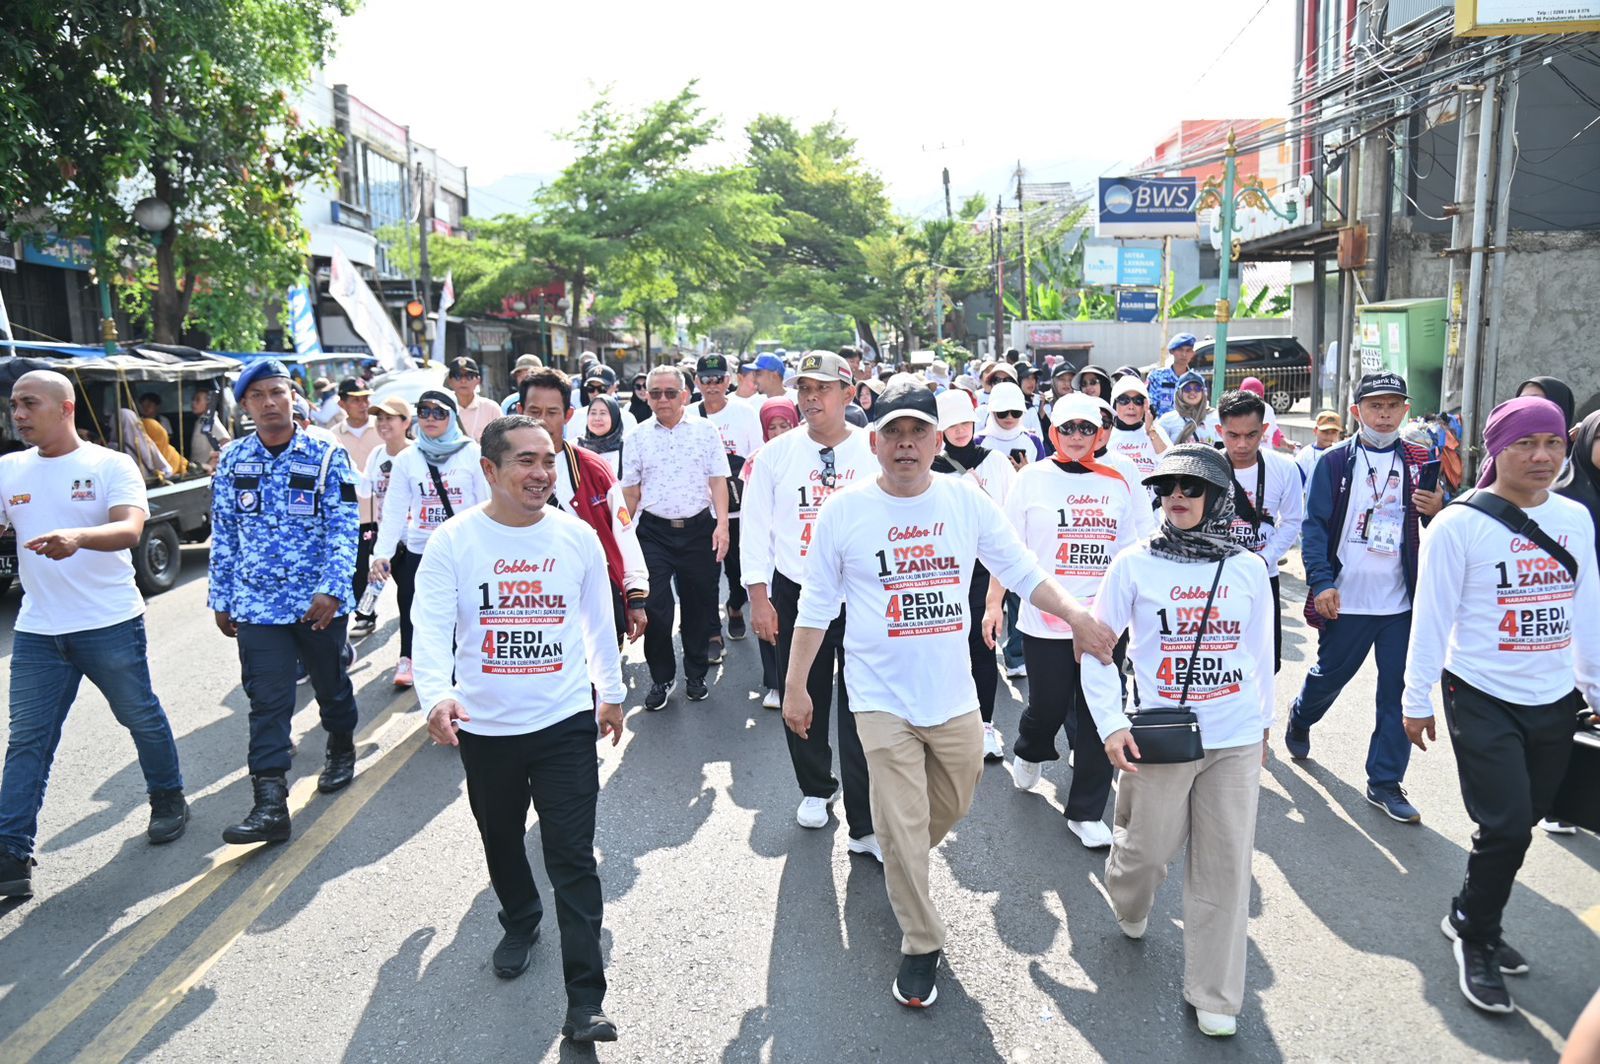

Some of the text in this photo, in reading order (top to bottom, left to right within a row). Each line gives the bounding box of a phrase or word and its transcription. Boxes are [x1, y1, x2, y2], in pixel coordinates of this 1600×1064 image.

[1136, 186, 1190, 207] BWS
[1362, 358, 1380, 366] CCTV
[1372, 378, 1390, 386] bank
[798, 486, 810, 507] 1
[419, 506, 428, 522] 4
[1057, 508, 1068, 528] 1
[1071, 508, 1104, 516] IYOS
[1072, 518, 1118, 530] ZAINUL
[800, 523, 812, 545] 4
[893, 544, 936, 560] IYOS
[1056, 543, 1069, 564] 4
[1070, 544, 1104, 554] DEDI
[875, 549, 892, 578] 1
[895, 556, 960, 575] ZAINUL
[1516, 557, 1560, 572] IYOS
[1495, 561, 1512, 588] 1
[1518, 570, 1574, 587] ZAINU
[479, 582, 494, 610] 1
[498, 580, 542, 595] IYOS
[1496, 588, 1526, 596] PASANGAN
[498, 594, 567, 609] ZAINUL
[902, 591, 944, 607] DEDI
[886, 594, 902, 623] 4
[902, 602, 963, 621] ERWAN
[1521, 606, 1565, 622] DEDI
[1156, 608, 1172, 636] 1
[1498, 610, 1519, 638] 4
[481, 630, 496, 660] 4
[496, 631, 542, 644] DEDI
[496, 642, 563, 659] ERWAN
[1156, 657, 1174, 686] 4
[1175, 658, 1222, 670] DEDI
[1175, 668, 1243, 686] ERWAN
